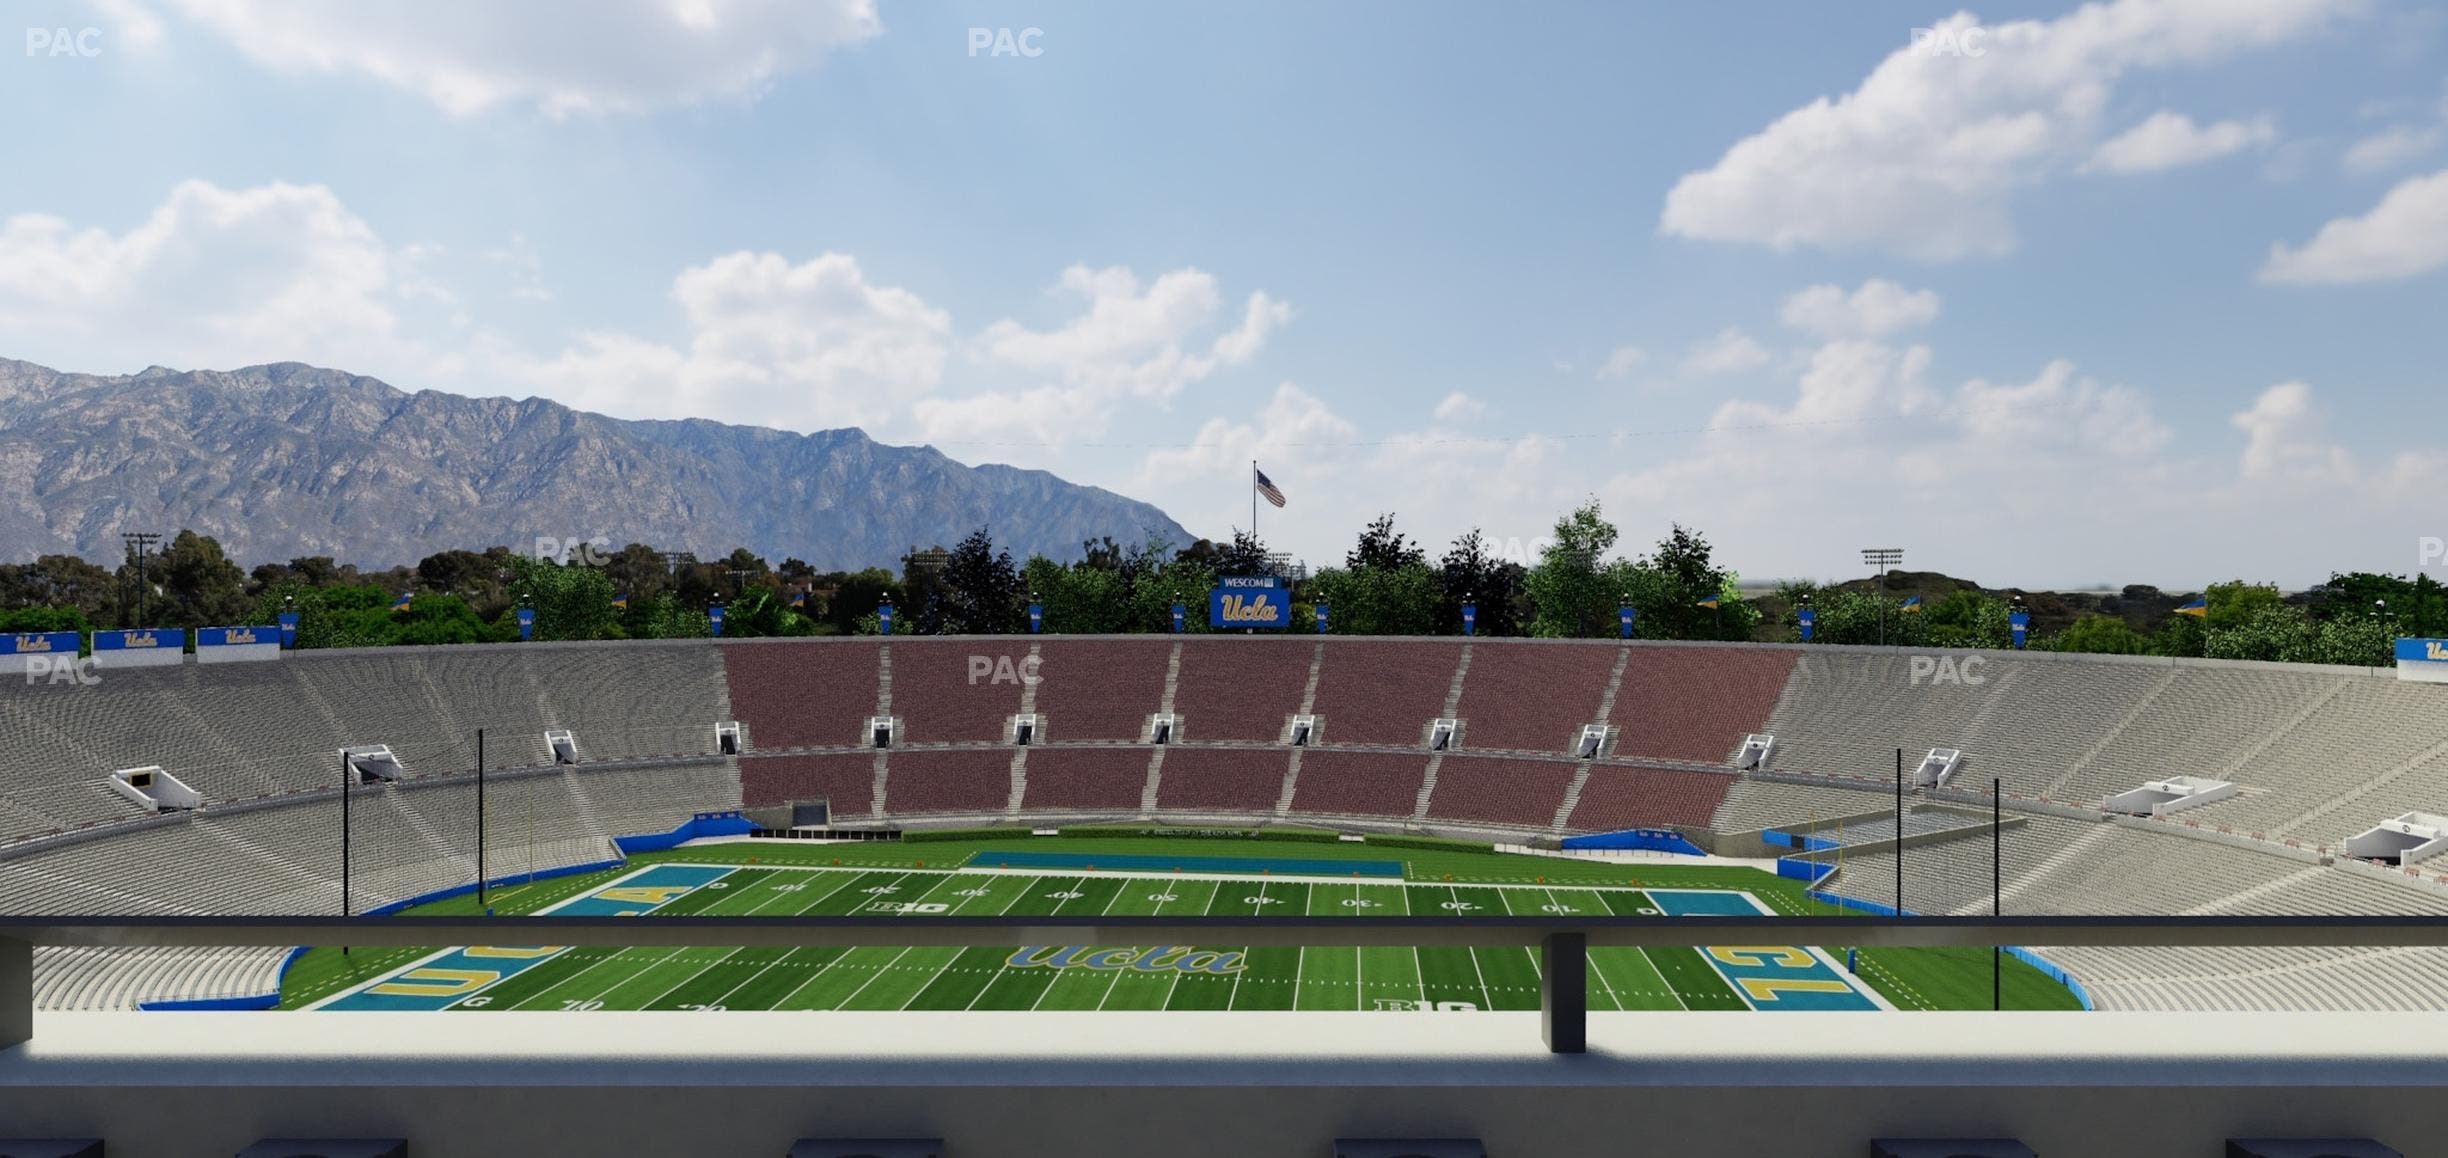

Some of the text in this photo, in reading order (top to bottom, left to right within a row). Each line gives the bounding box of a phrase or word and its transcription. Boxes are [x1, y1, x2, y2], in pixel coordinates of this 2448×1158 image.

[1225, 578, 1264, 588] WESCOM
[1221, 594, 1278, 621] Ucla
[462, 996, 494, 1007] G
